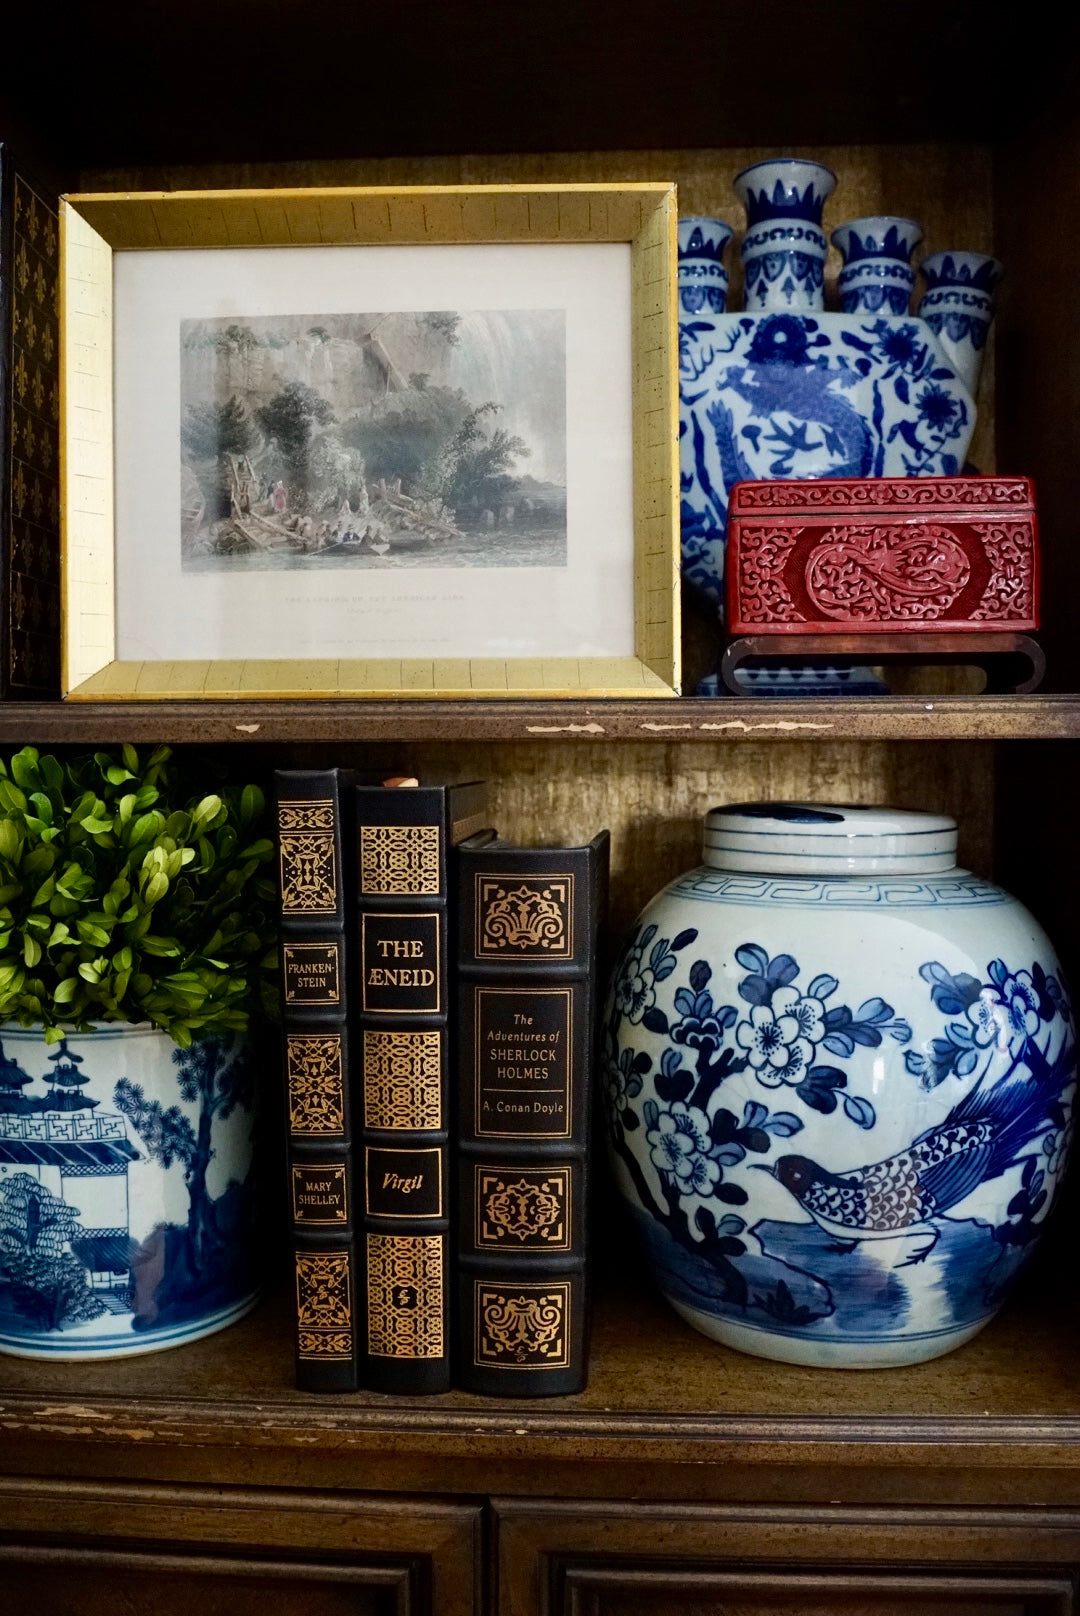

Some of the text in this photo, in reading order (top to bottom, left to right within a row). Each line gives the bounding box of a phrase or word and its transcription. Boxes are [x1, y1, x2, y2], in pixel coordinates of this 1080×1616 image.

[377, 940, 424, 958] THE
[288, 963, 335, 974] FRANKEN-
[297, 977, 326, 988] STEIN
[367, 968, 435, 987] ÆNEID
[513, 1014, 533, 1025] The
[487, 1030, 560, 1043] Adventures of
[490, 1048, 557, 1061] SHERLOCK
[497, 1066, 549, 1080] HOLMES
[483, 1100, 564, 1115] A. Conan Doyle
[305, 1181, 332, 1192] MARY
[382, 1173, 424, 1194] Virgil
[298, 1194, 341, 1205] SHELLEY
